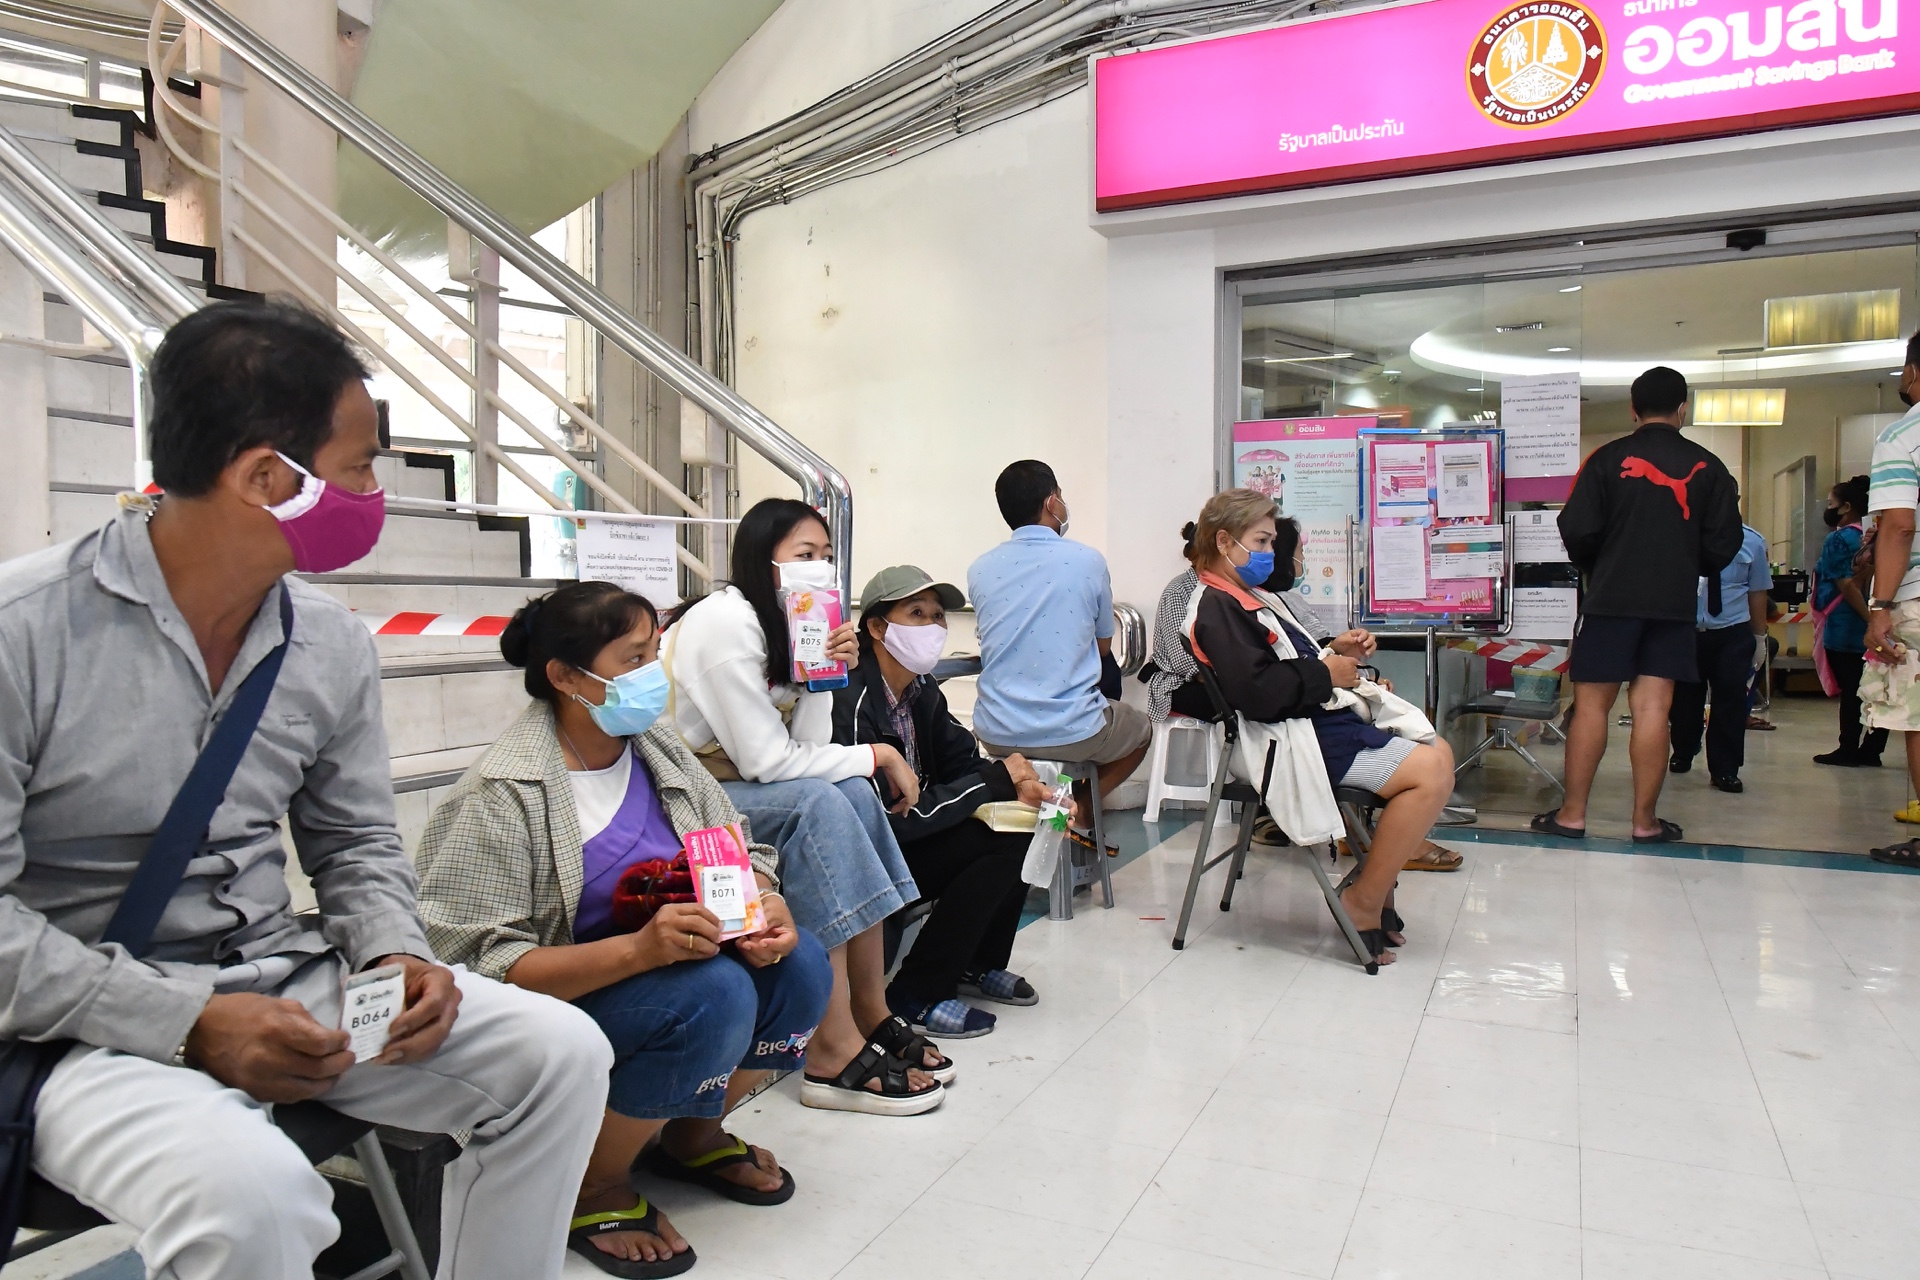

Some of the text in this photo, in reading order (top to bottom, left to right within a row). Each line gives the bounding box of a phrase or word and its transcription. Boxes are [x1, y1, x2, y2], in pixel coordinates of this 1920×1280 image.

[1623, 48, 1896, 103] Government Savings Bank
[1278, 118, 1405, 153] รัฐบาลเป็นประกัน
[1333, 529, 1342, 537] by
[800, 637, 822, 646] B075
[711, 887, 735, 899] B071
[352, 1007, 390, 1029] B064
